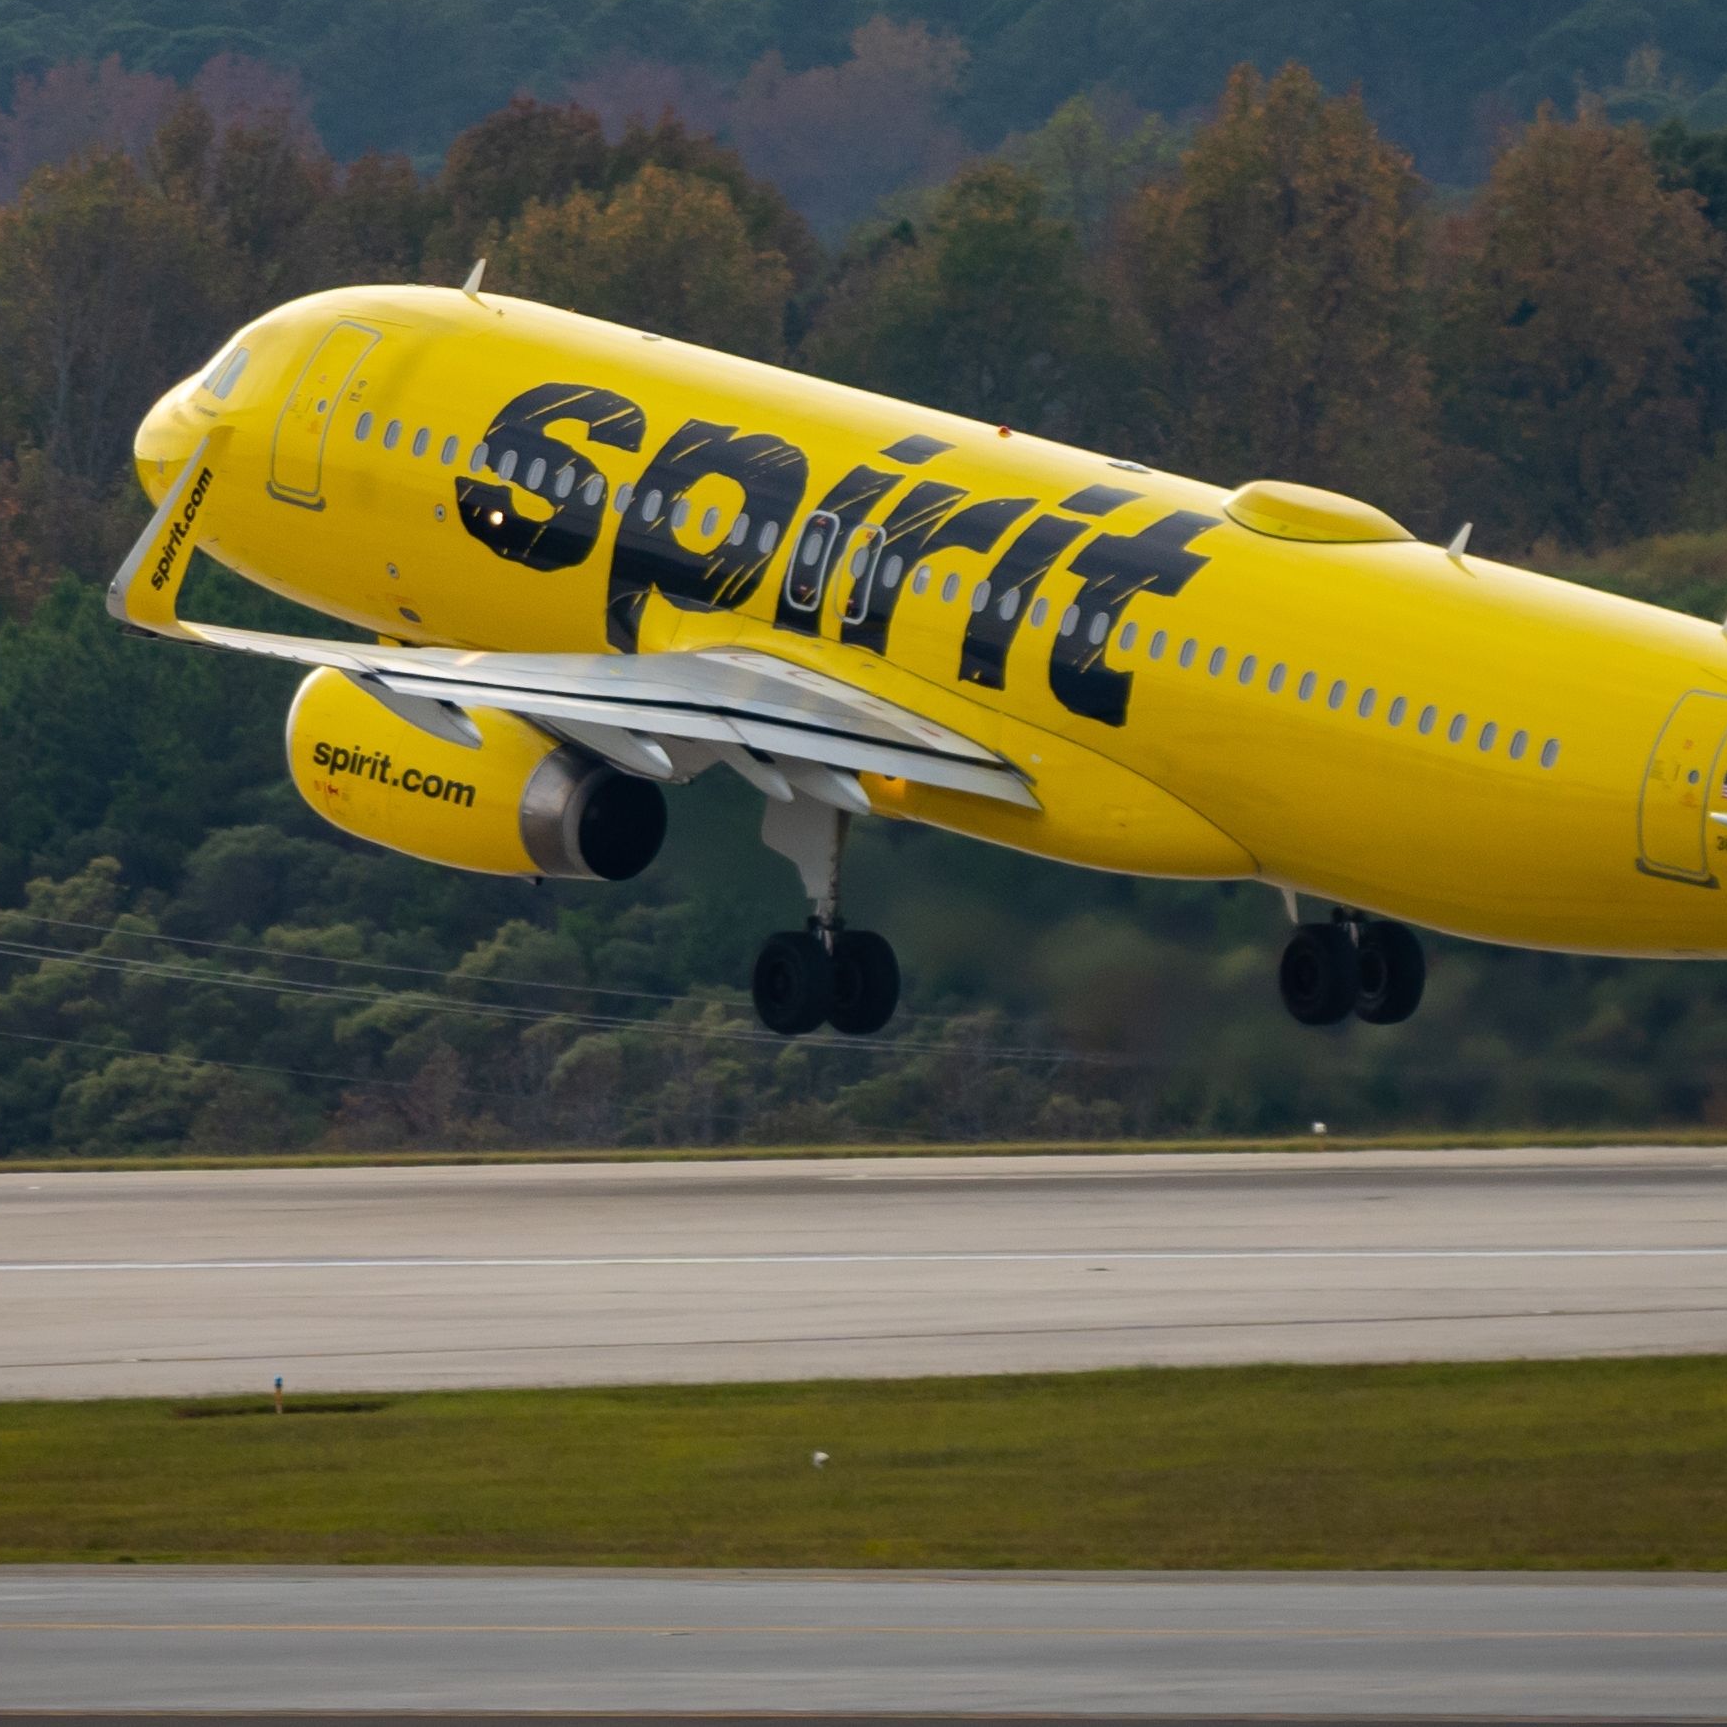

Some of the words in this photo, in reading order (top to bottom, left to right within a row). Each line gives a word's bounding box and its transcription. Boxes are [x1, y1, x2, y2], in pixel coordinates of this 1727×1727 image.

[151, 467, 213, 591] spirit.com
[456, 382, 1223, 727] spirit
[313, 741, 476, 807] spirit.com
